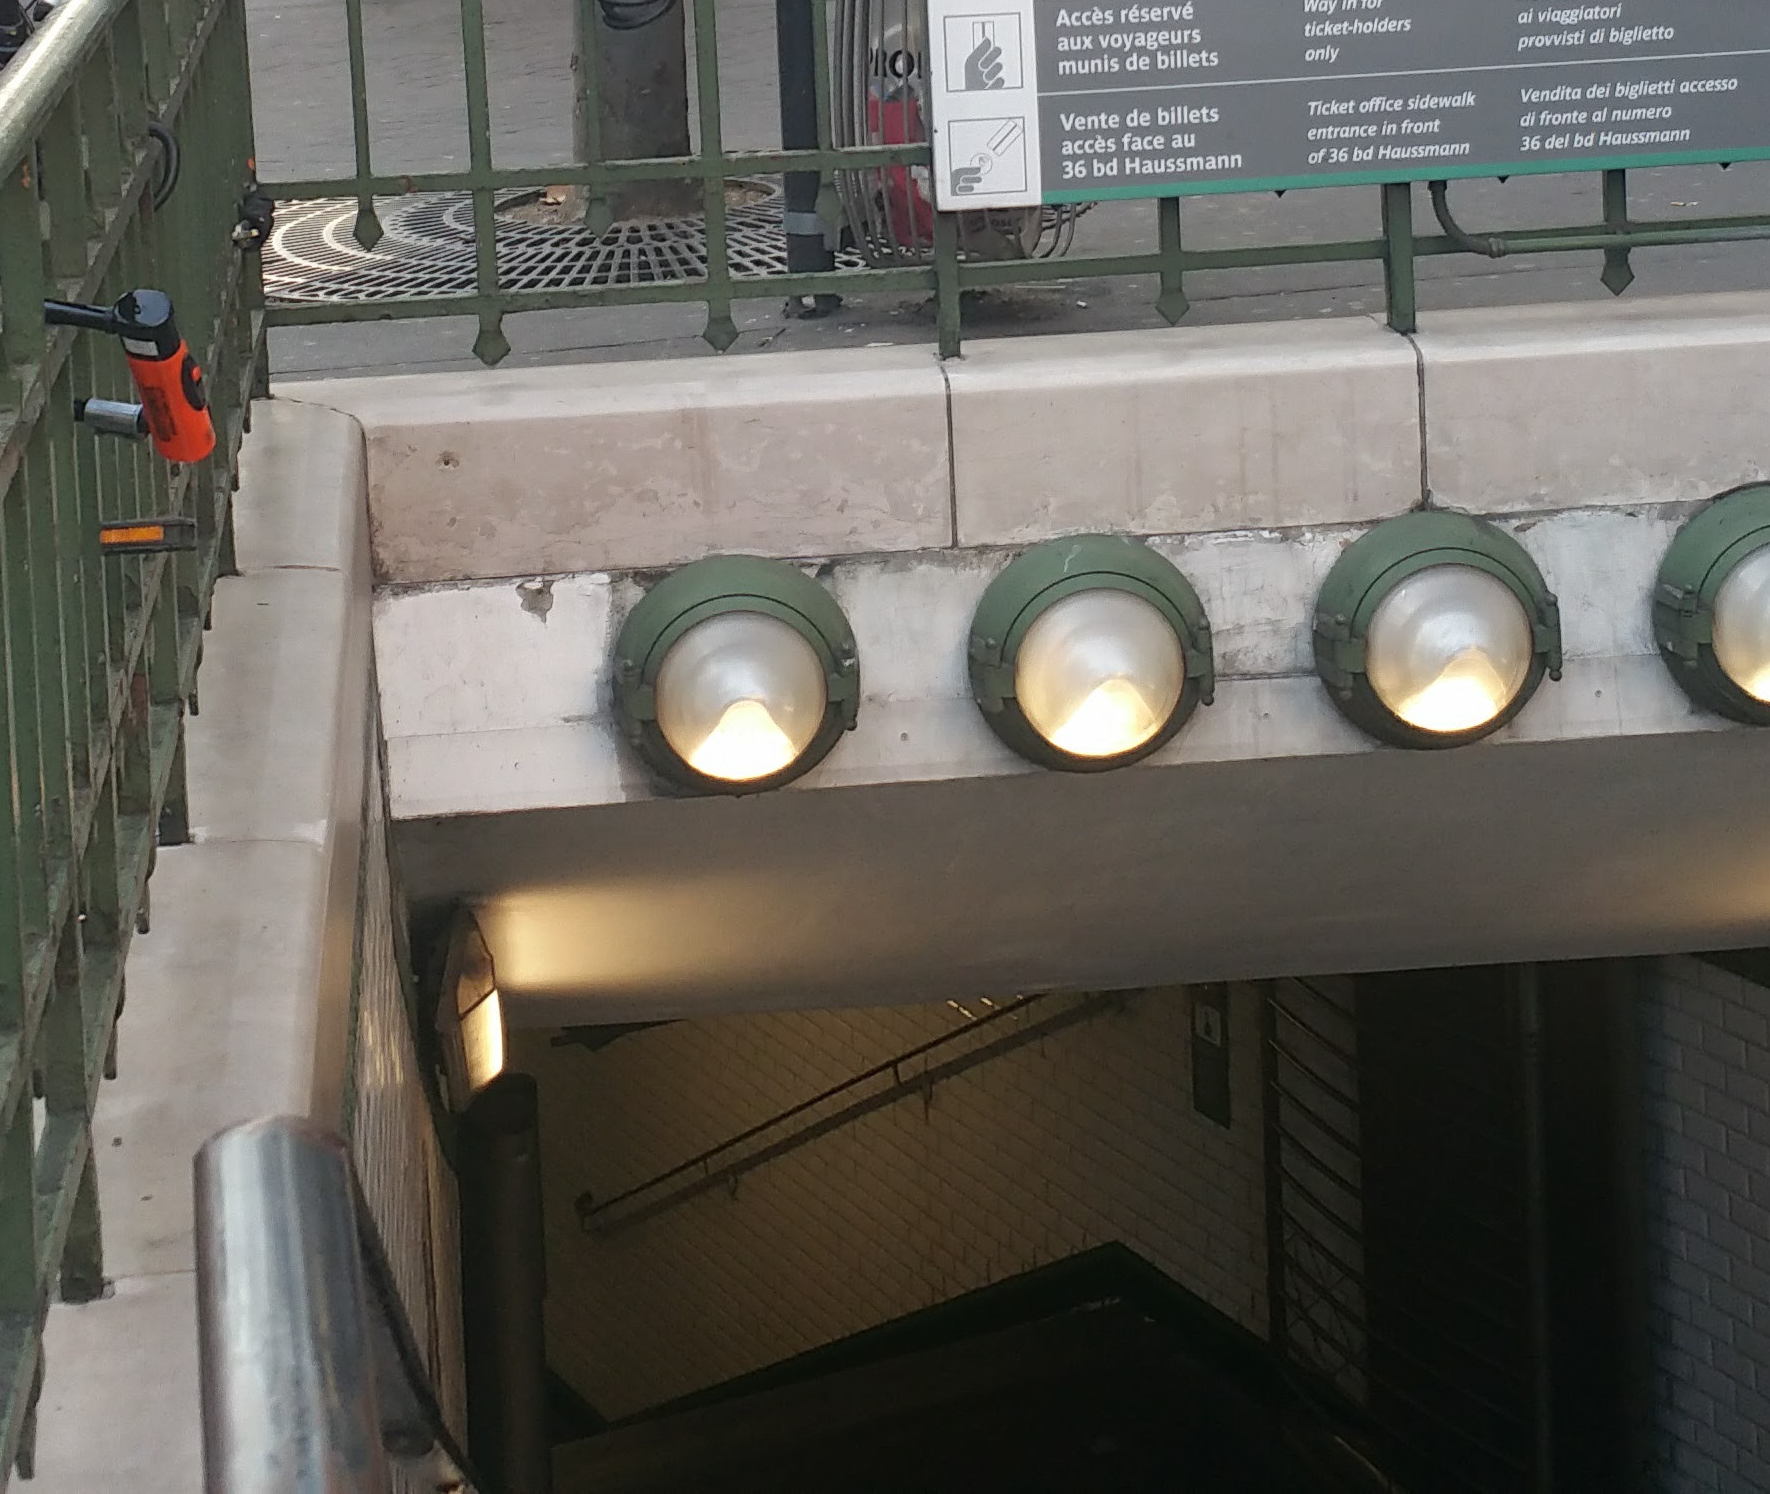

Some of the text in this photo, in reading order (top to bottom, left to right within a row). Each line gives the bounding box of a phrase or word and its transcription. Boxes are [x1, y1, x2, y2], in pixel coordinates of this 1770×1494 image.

[1056, 1, 1194, 27] Accès réservé
[1518, 4, 1622, 24] ai viaggiatori
[1304, 17, 1411, 37] ticket-holders
[1518, 25, 1674, 51] provvisti di biglietto
[1057, 28, 1201, 52] aux voyageurs
[1058, 49, 1219, 75] munis de billets
[1305, 45, 1339, 63] only
[1521, 77, 1738, 103] Vendita dei biglietti accesso
[1308, 91, 1476, 116] Ticket office sidewalk
[1060, 105, 1219, 131] Vente de billets
[1520, 106, 1672, 127] di fronte al numero
[1307, 118, 1441, 140] entrance in front
[1520, 128, 1690, 151] 36 del bd Haussmann
[1062, 133, 1196, 155] accès face au
[1308, 143, 1470, 164] of 36 bd Haussmann
[1062, 154, 1242, 179] 36 bd Haussmann
